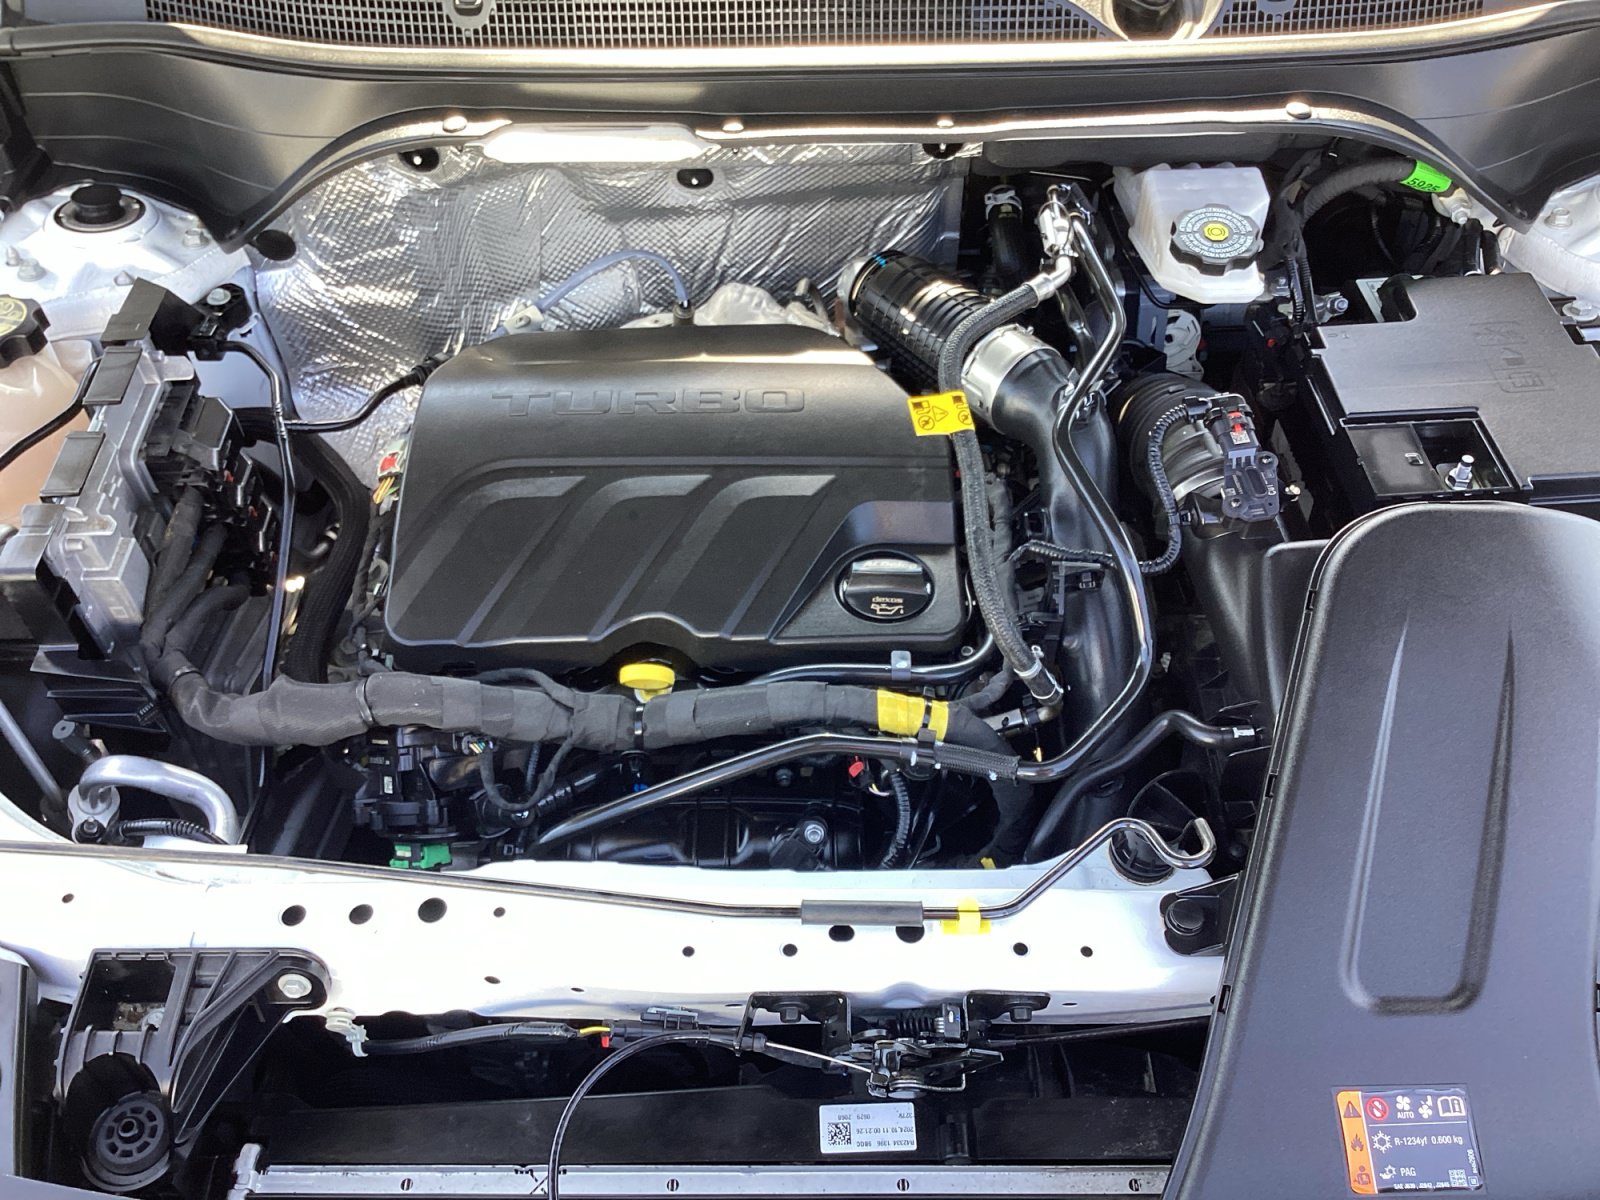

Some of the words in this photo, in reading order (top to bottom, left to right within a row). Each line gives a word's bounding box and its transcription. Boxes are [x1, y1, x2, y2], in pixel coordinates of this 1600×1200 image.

[492, 389, 805, 417] TURBO
[1394, 1136, 1428, 1147] R-1234yf
[1431, 1136, 1452, 1144] 0.600
[1453, 1135, 1463, 1145] kg
[1400, 1167, 1417, 1177] PAG
